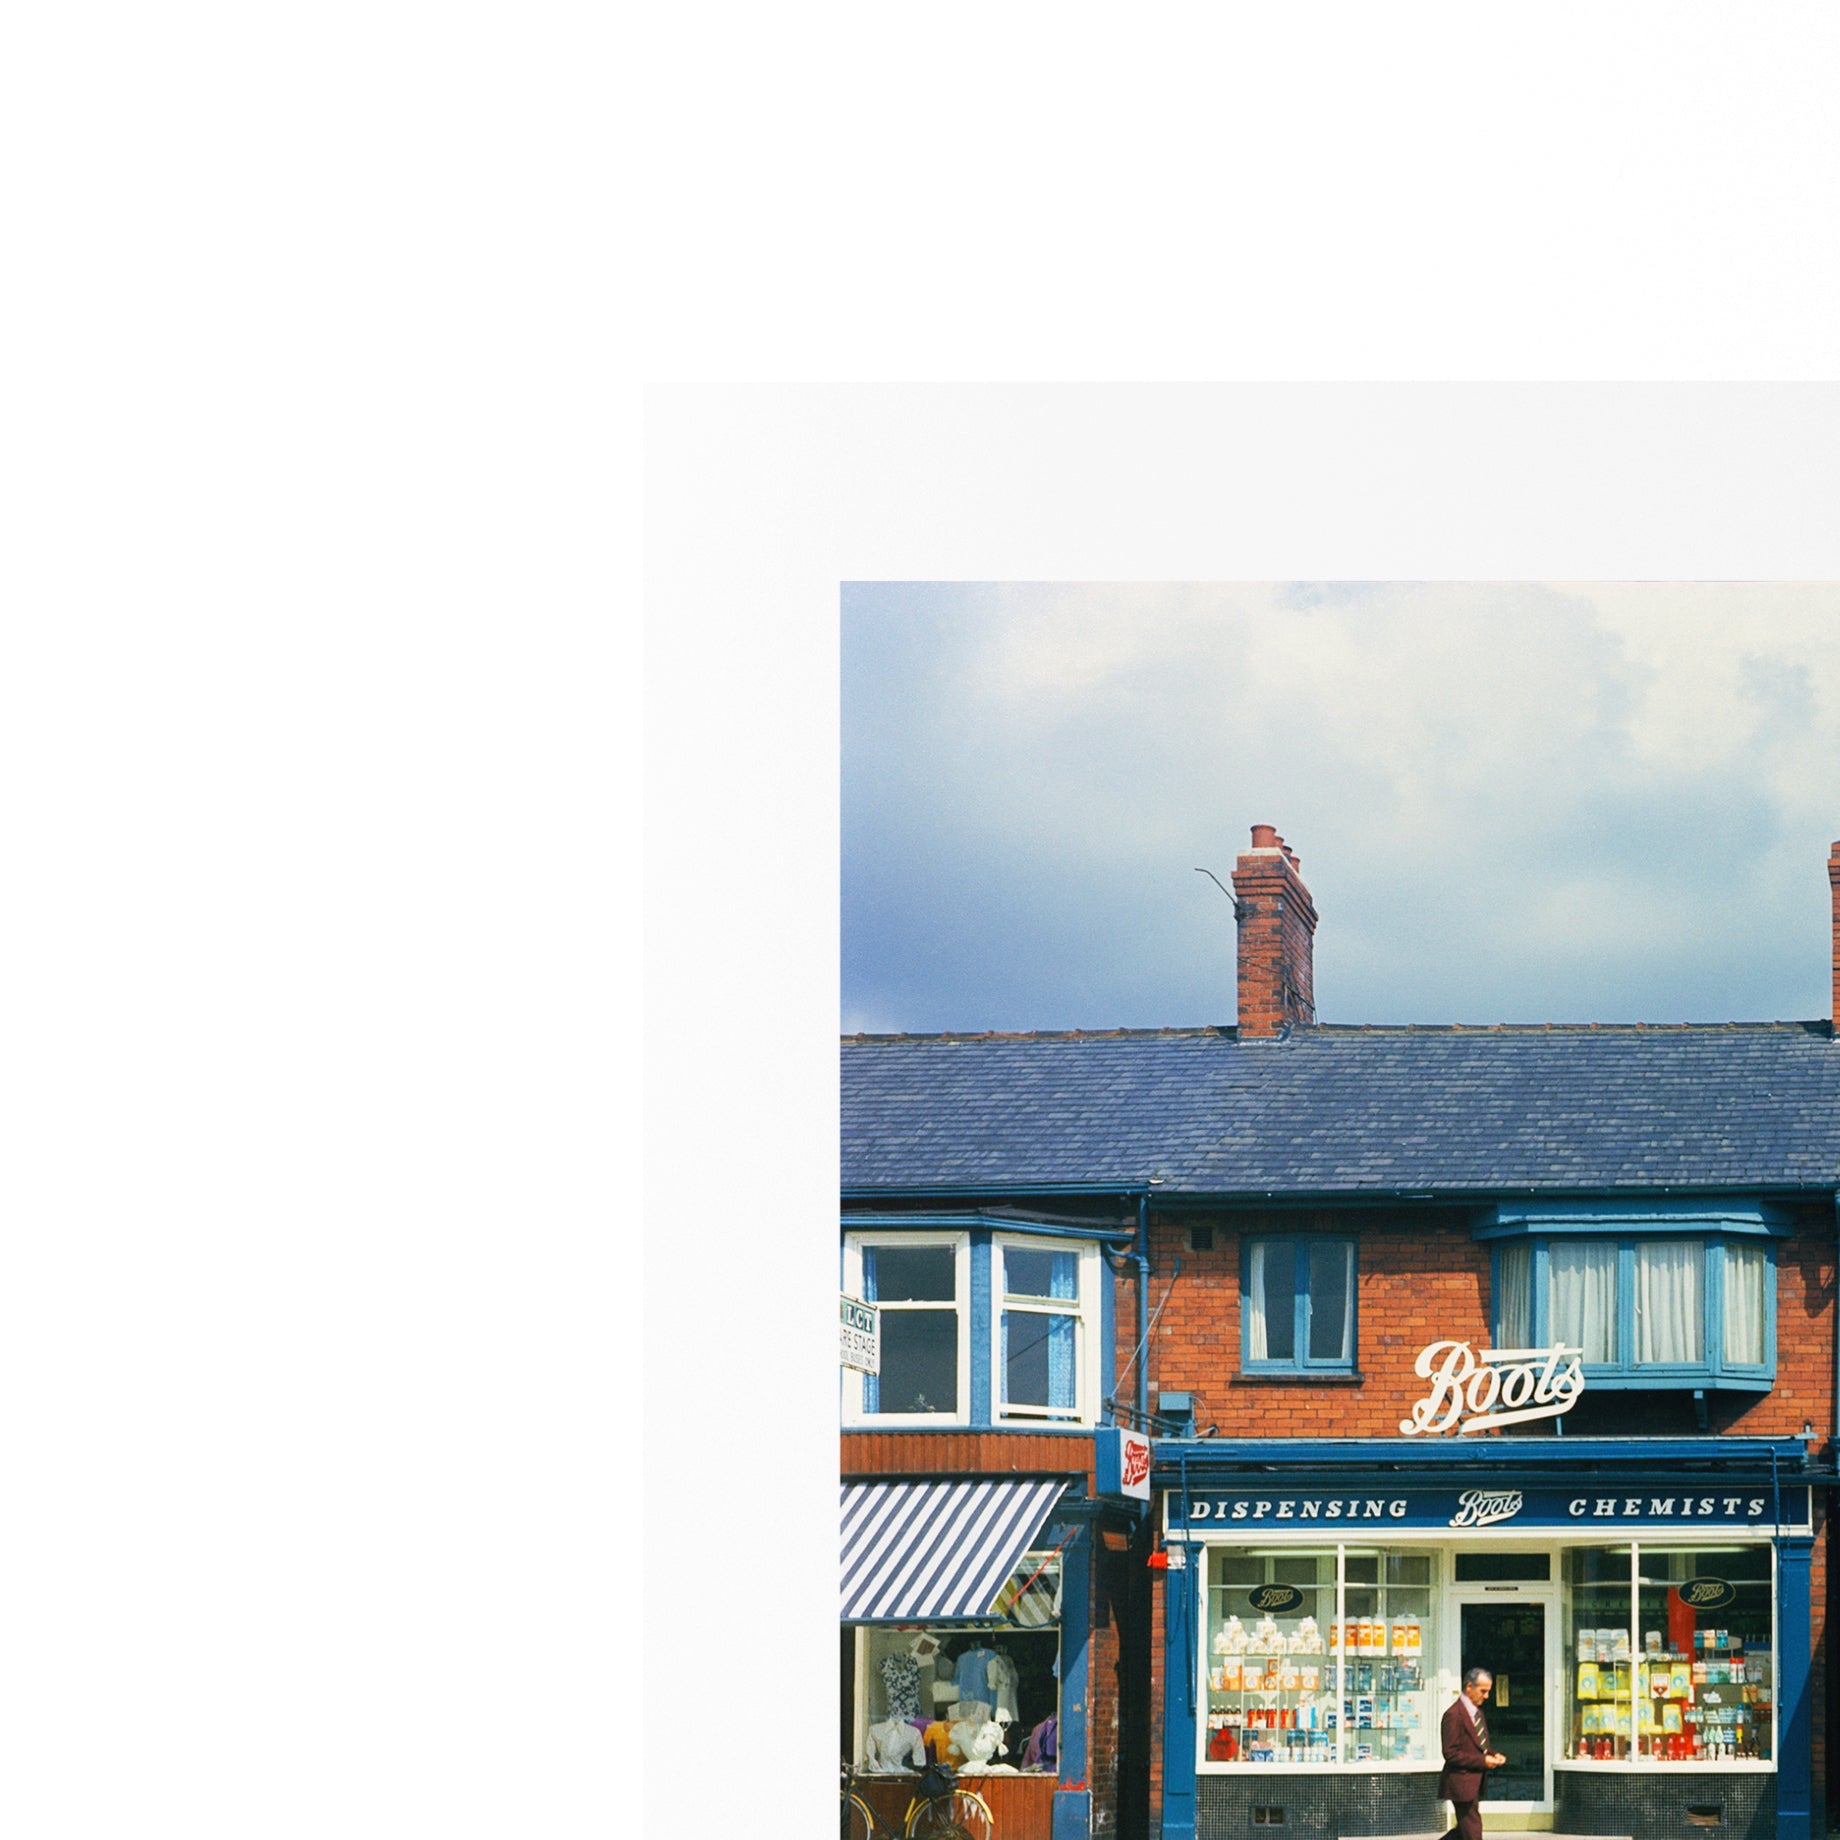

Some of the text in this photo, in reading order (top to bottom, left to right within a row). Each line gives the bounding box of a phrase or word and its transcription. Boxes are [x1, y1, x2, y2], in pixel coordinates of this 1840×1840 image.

[846, 1305, 872, 1332] LCT
[853, 1333, 875, 1356] STAGE
[1400, 1341, 1585, 1435] Boots
[1122, 1440, 1149, 1487] Boots
[1190, 1490, 1765, 1527] DISPENSING Boots CHEMISTS
[1257, 1588, 1294, 1607] Boots
[1688, 1583, 1724, 1602] Boots
